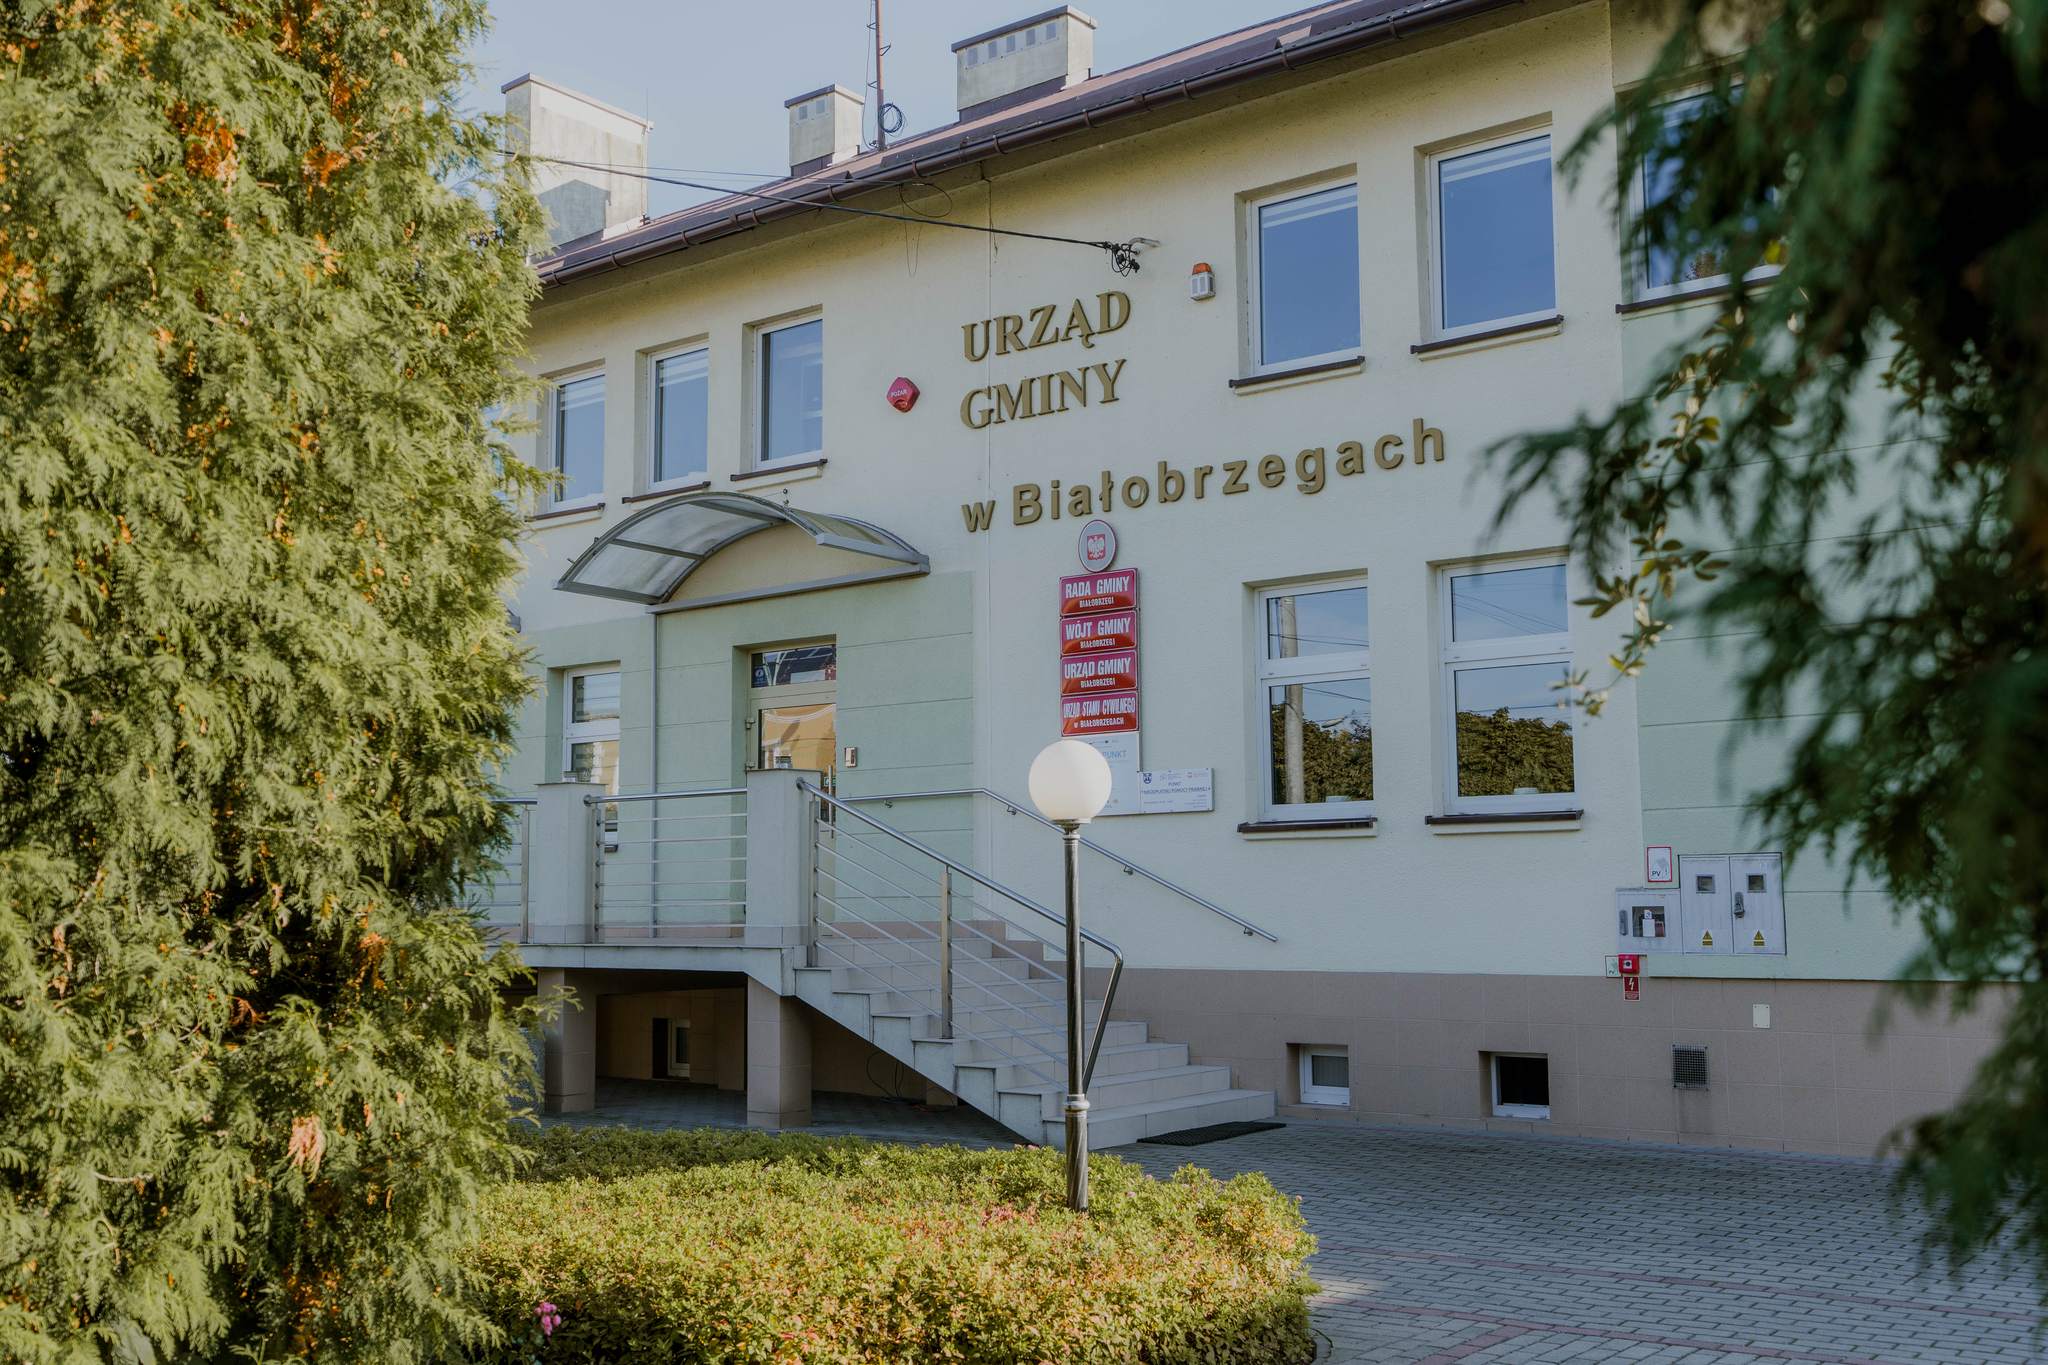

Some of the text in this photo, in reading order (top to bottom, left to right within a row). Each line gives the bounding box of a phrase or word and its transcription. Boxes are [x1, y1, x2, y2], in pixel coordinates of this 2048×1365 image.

[961, 290, 1131, 362] URZĄD
[959, 358, 1127, 429] GMINY
[961, 417, 1445, 533] w Białobrzegach
[1065, 575, 1130, 599] RADA GMINY
[1065, 617, 1131, 640] WÓJT GMINY
[1064, 657, 1131, 679] URZĄD GMINY
[1082, 700, 1100, 717] STANU
